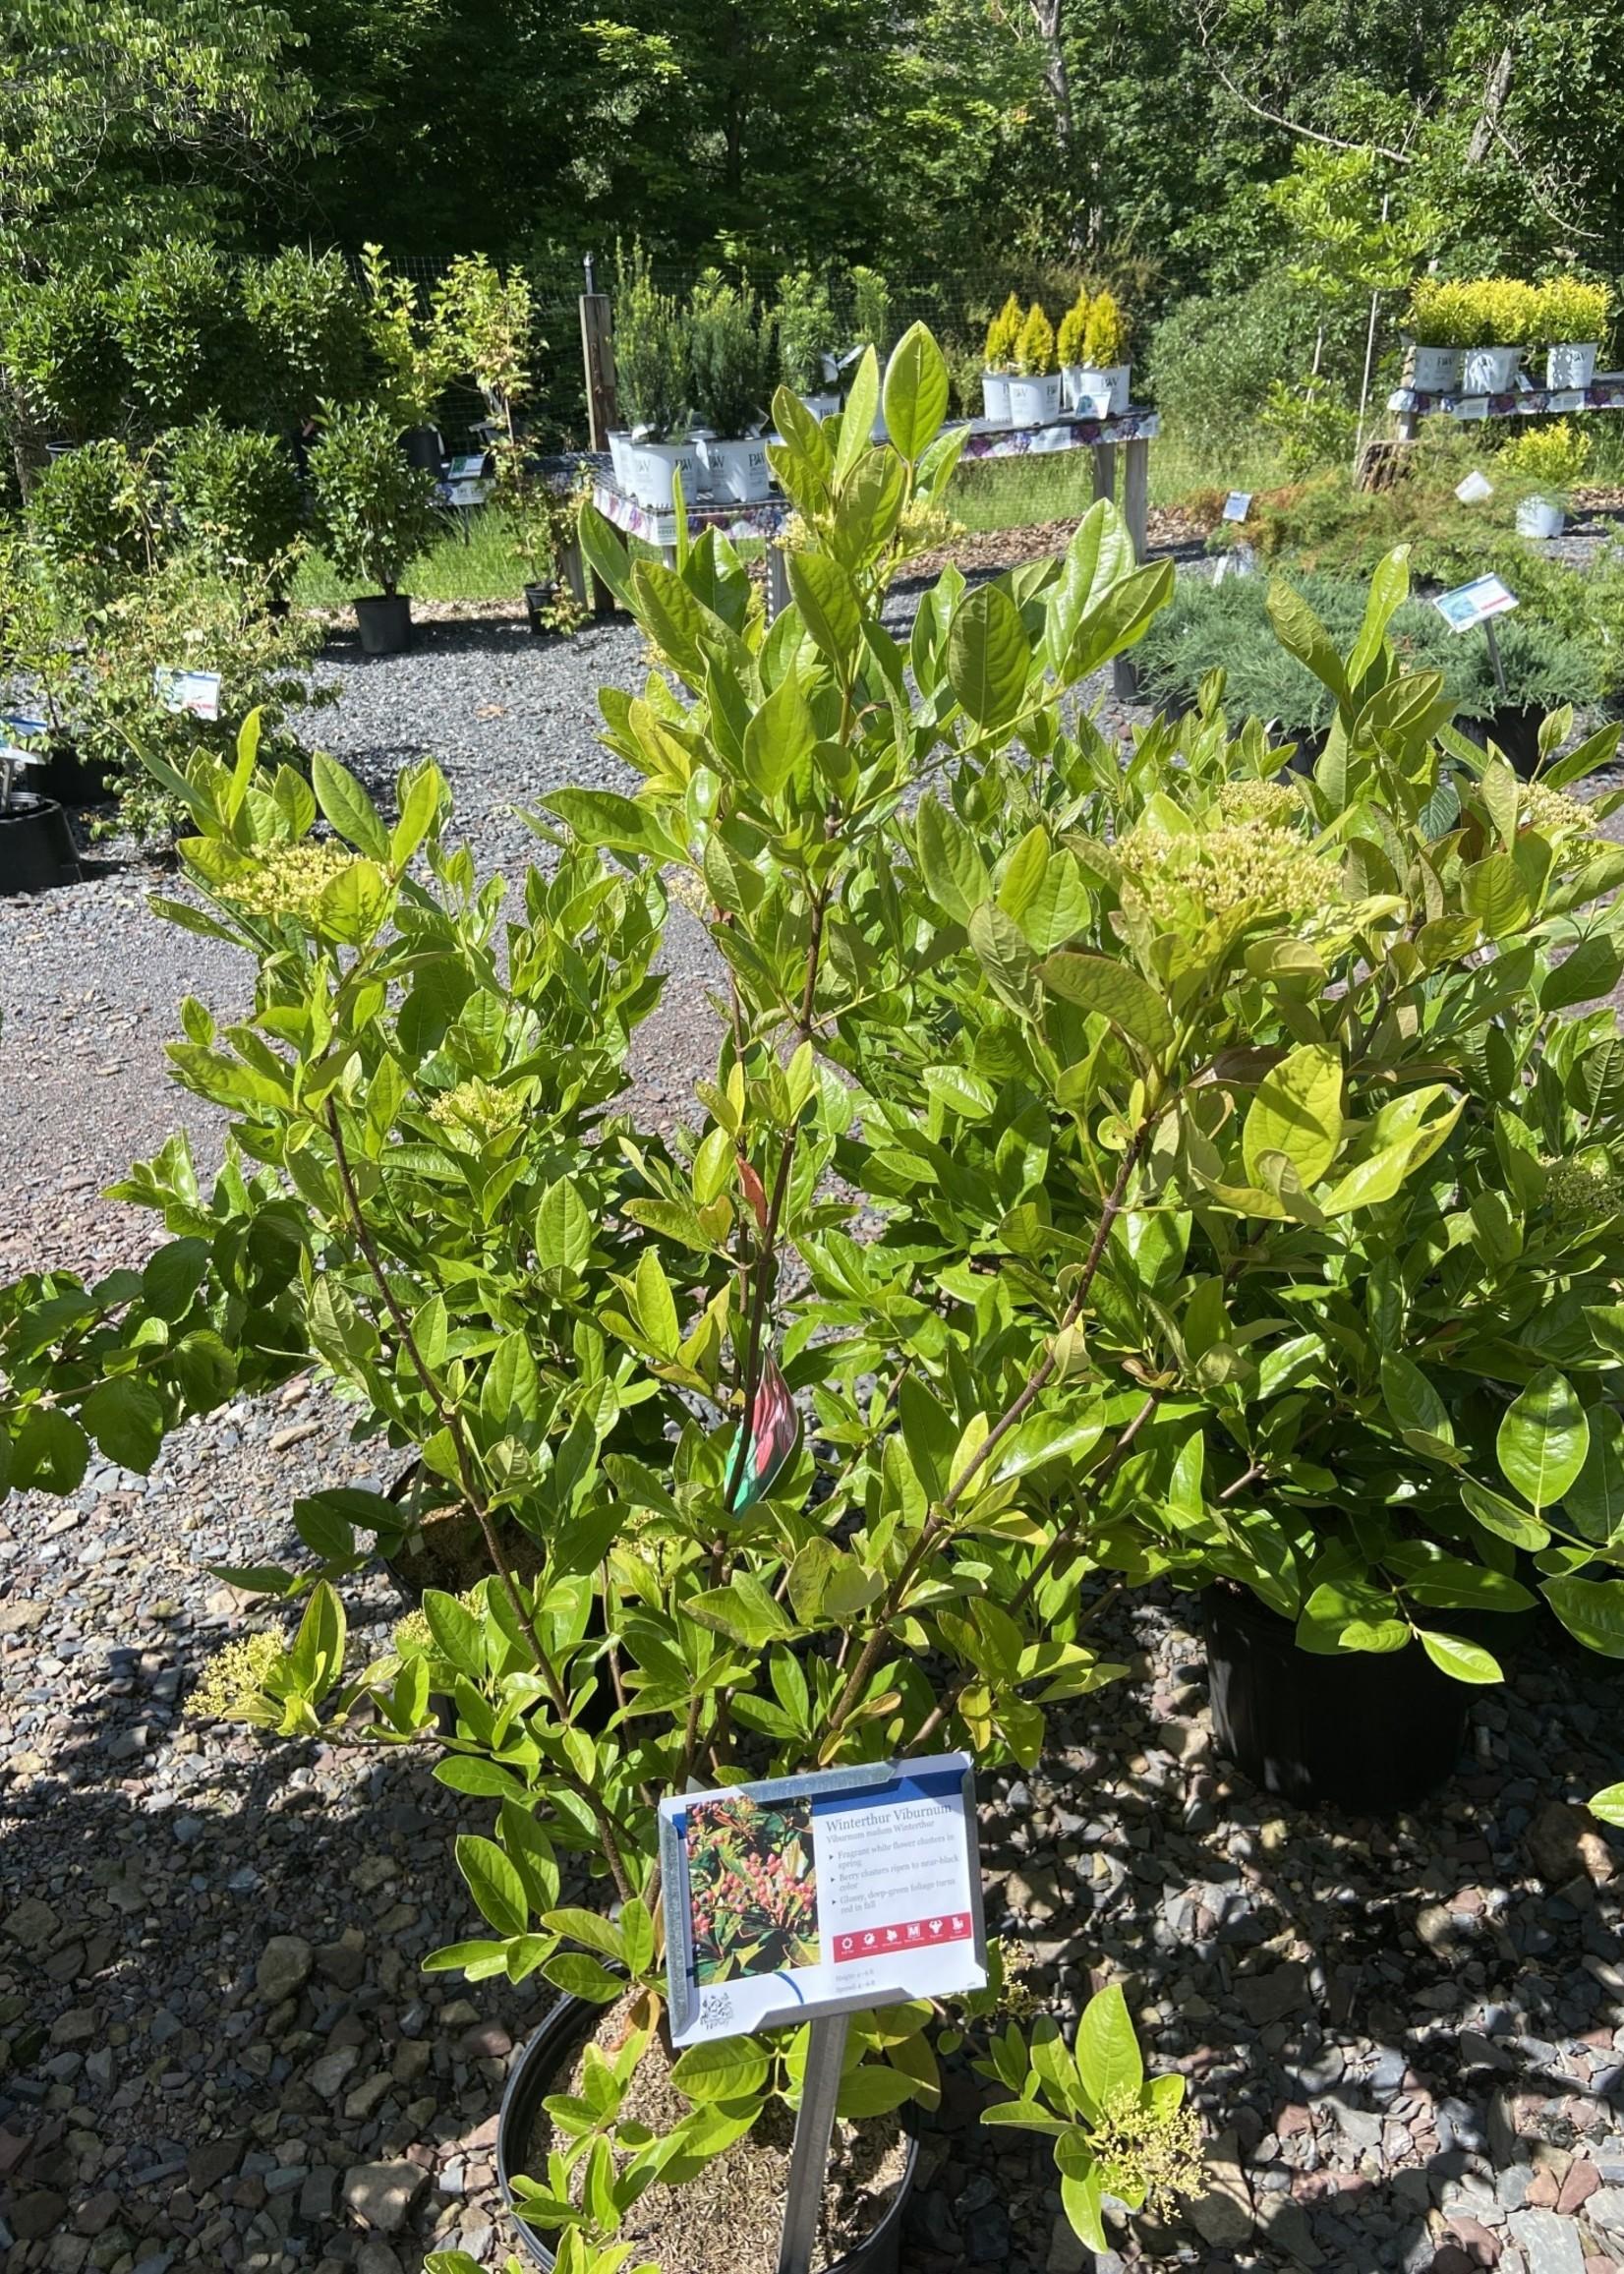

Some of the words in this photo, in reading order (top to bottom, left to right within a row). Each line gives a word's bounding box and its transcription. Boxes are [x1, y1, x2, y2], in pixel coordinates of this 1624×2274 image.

[826, 1812, 892, 1833] Winterthur
[893, 1803, 953, 1821] Viburnum
[826, 1831, 865, 1843] Viburnum
[838, 1846, 870, 1861] Fragrant
[871, 1841, 893, 1853] white
[893, 1837, 916, 1850] flower
[917, 1835, 945, 1846] clusters
[839, 1859, 862, 1871] spring
[840, 1872, 860, 1885] Berry
[861, 1867, 890, 1879] clusters
[891, 1864, 910, 1874] ripen
[911, 1860, 919, 1869] to
[920, 1854, 958, 1868] near-black
[868, 1886, 909, 1899] deep-green
[910, 1880, 935, 1894] foliage
[936, 1878, 956, 1889] turns
[841, 1903, 854, 1914] red
[854, 1903, 862, 1912] in
[863, 1901, 876, 1911] fall
